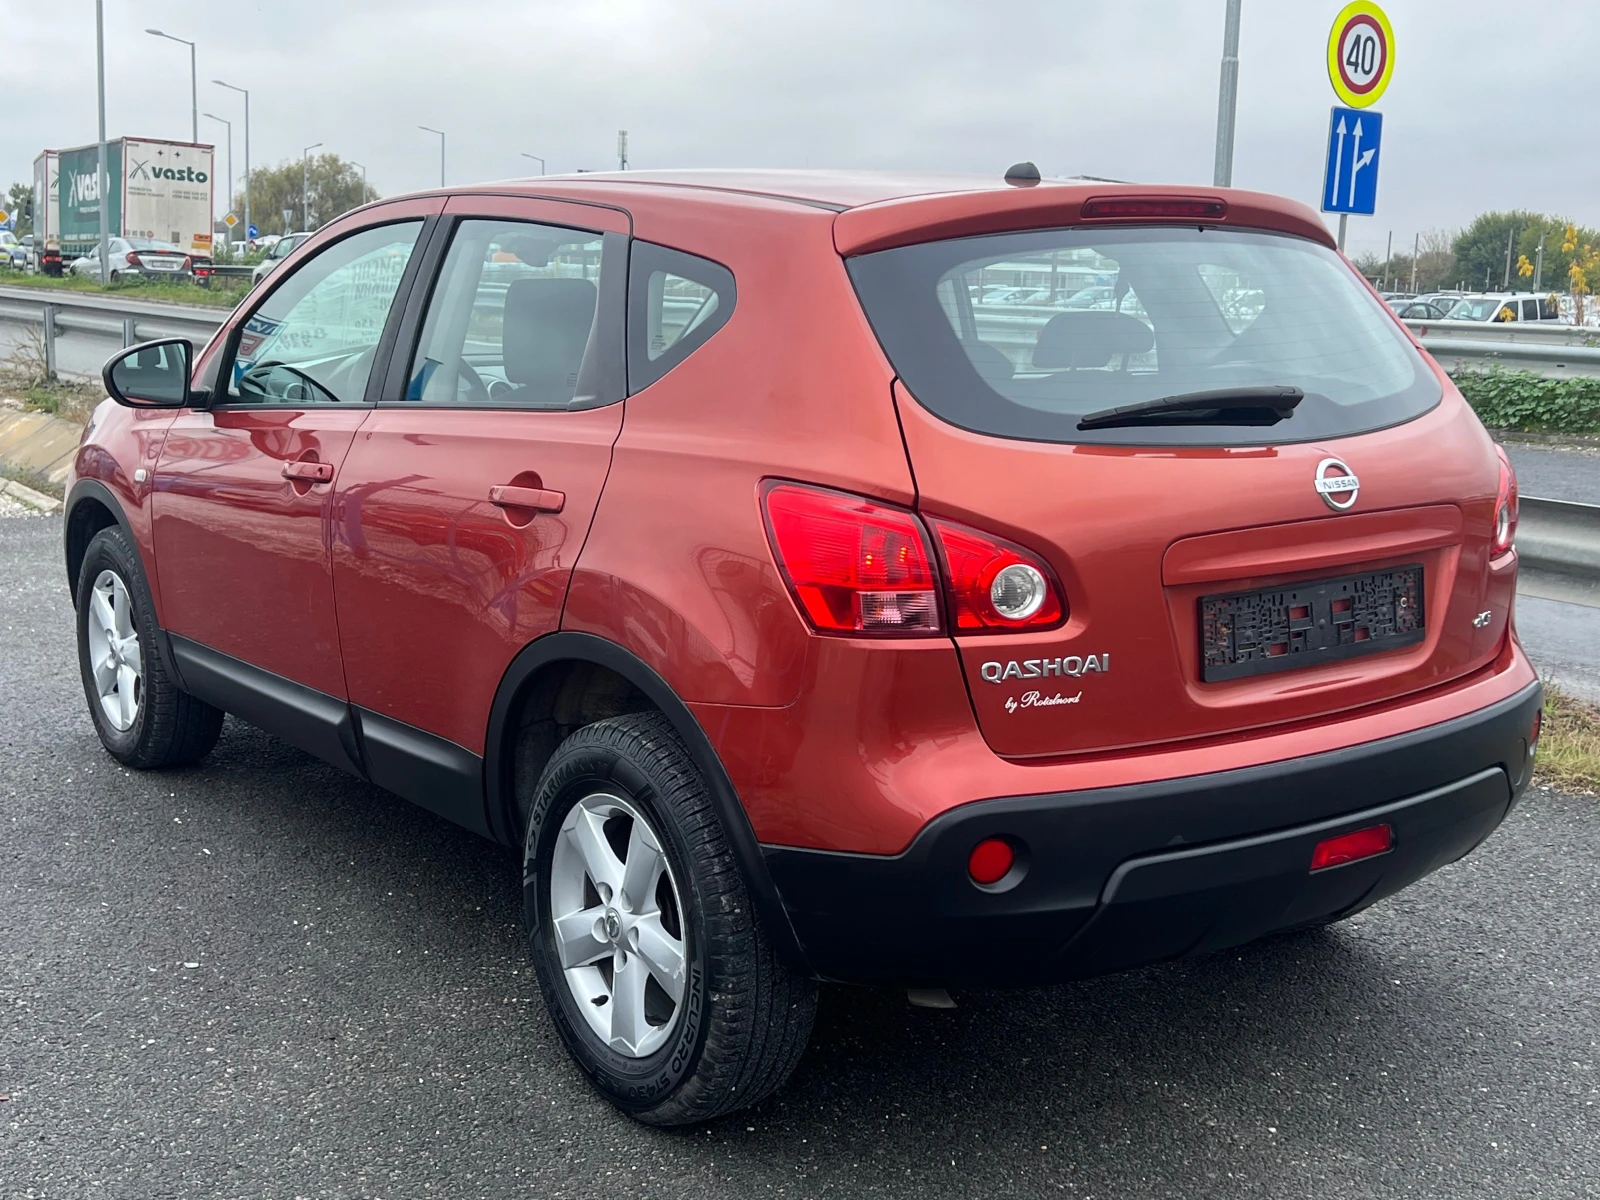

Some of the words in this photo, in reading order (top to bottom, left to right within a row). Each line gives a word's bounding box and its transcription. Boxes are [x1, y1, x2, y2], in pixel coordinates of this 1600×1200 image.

[1346, 34, 1376, 76] 40
[152, 166, 208, 183] vasto
[1323, 478, 1358, 490] NISSAN
[981, 653, 1109, 684] QASHQAI
[1004, 697, 1018, 714] by
[672, 967, 702, 1071] INCURRO
